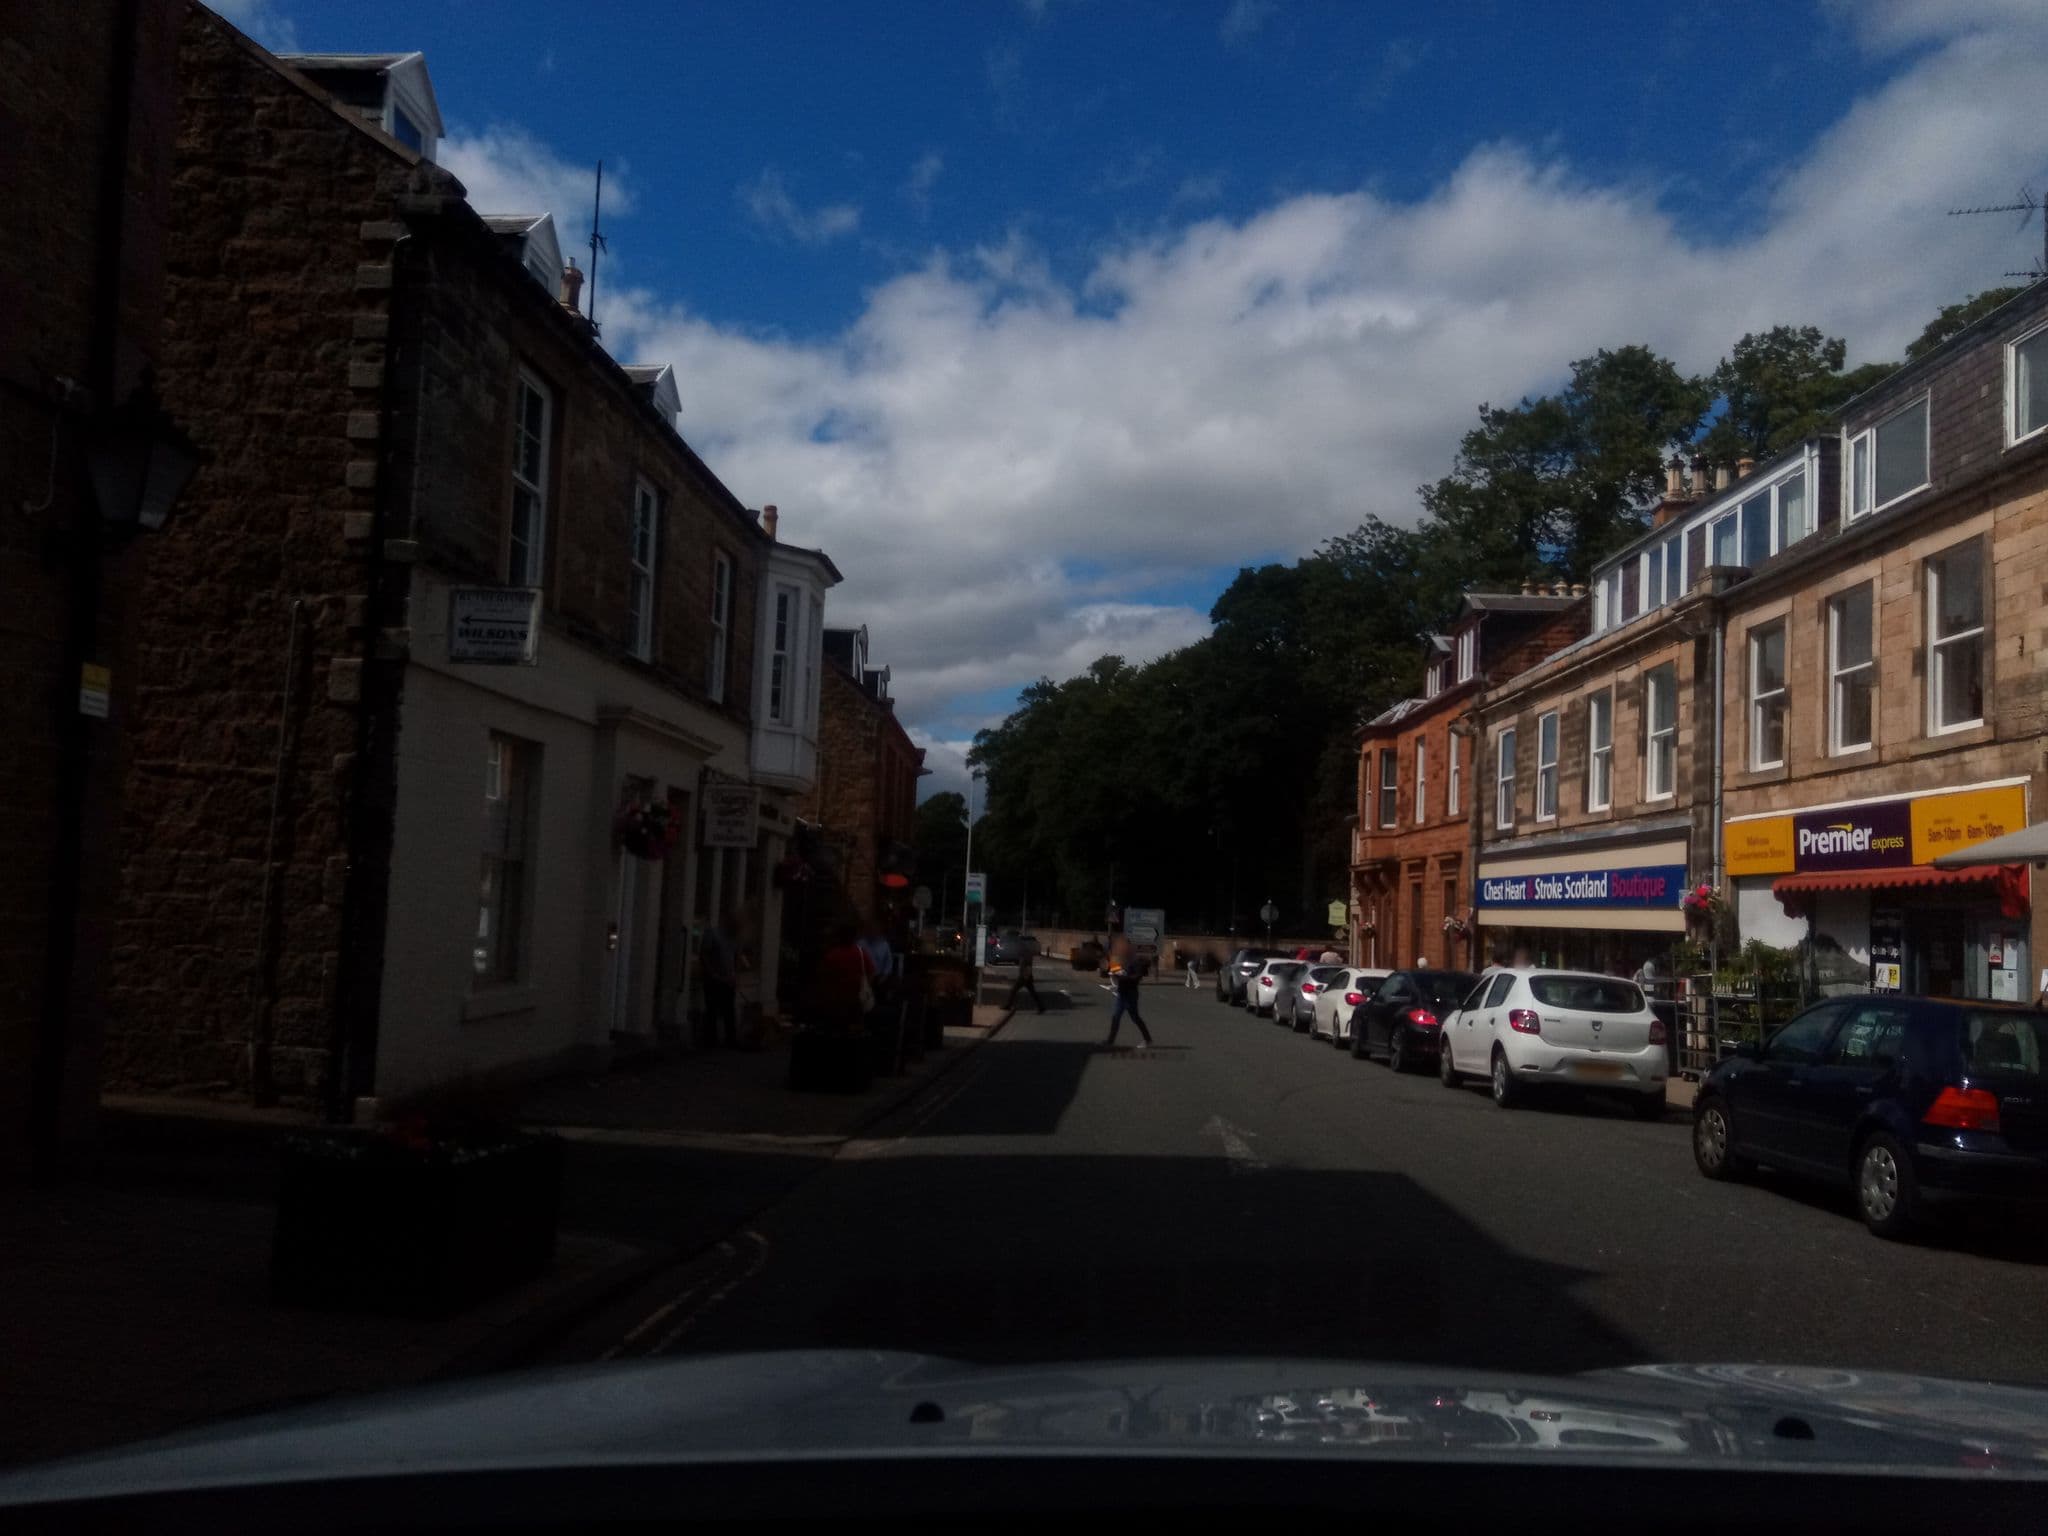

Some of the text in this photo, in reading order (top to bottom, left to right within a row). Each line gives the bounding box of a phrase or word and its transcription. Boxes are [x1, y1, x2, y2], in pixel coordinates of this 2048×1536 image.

[1799, 822, 1905, 855] Premier express
[1483, 878, 1504, 900] Chest
[1504, 879, 1526, 900] Heart
[1534, 875, 1562, 900] Stroke
[1564, 871, 1608, 899] Scotland
[1611, 872, 1666, 904] Boutique
